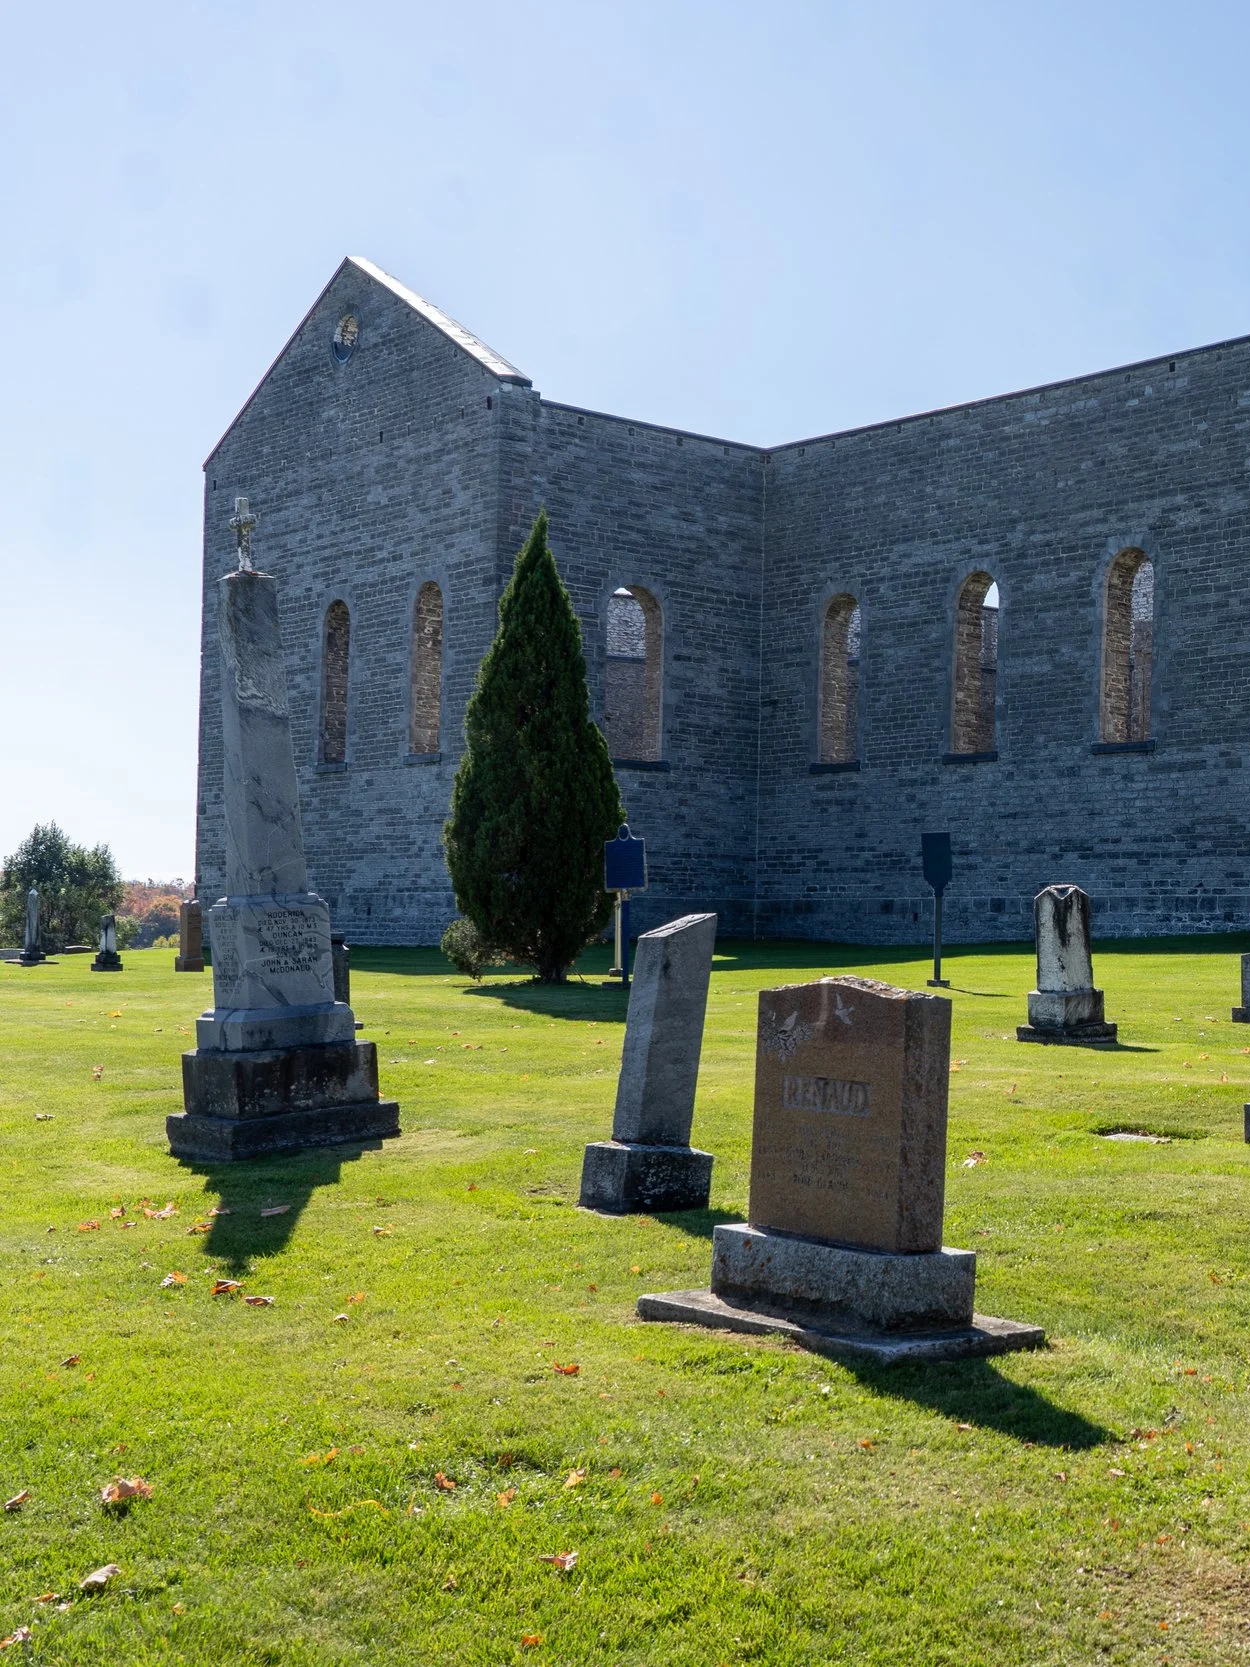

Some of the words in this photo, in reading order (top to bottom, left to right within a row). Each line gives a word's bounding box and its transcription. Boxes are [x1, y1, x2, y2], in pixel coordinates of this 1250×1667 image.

[267, 910, 305, 919] RODERICK
[272, 930, 303, 939] DUNCAN
[261, 959, 282, 968] JOHN
[292, 956, 318, 965] SARAH
[269, 963, 311, 974] McDONALD
[783, 1076, 870, 1115] RENAUD
